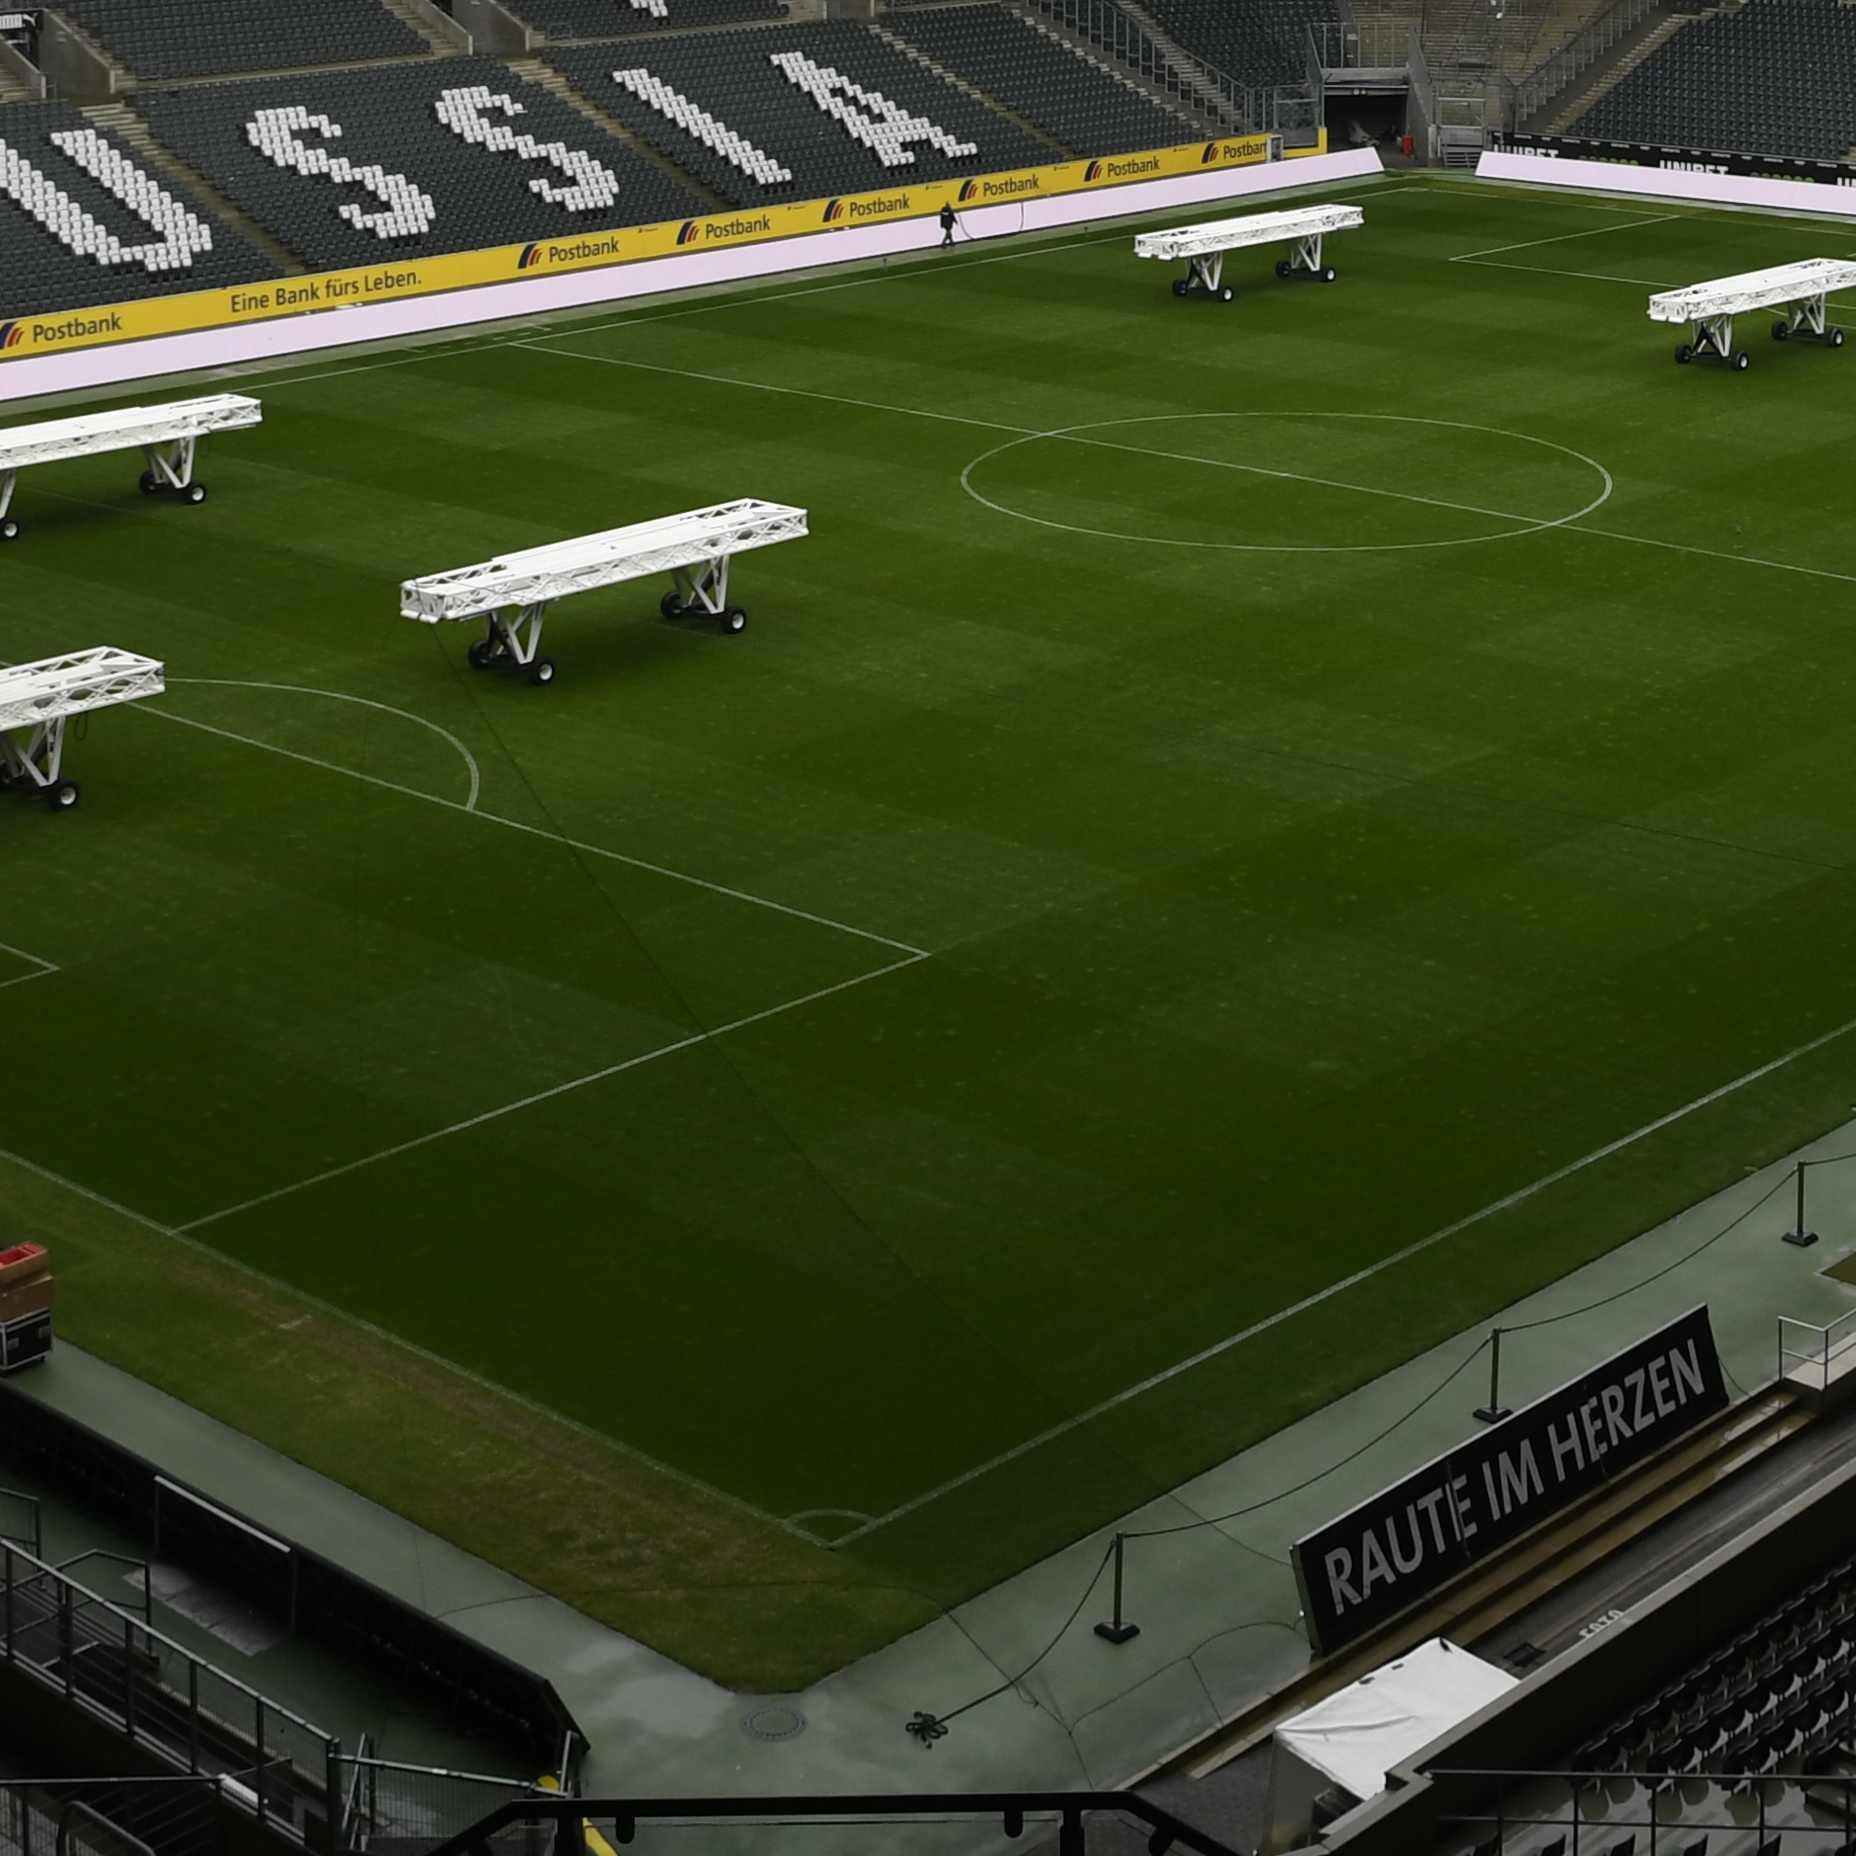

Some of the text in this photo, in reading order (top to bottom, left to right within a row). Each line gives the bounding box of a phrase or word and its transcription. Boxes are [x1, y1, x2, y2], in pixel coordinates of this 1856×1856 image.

[1223, 140, 1266, 159] Postban
[1107, 157, 1160, 180] Postbank
[982, 176, 1039, 197] Postbank
[848, 197, 910, 219] Postbank
[704, 215, 771, 242] Postbank
[548, 236, 620, 264] Postbank
[230, 269, 422, 313] Eine Bank fürs Leben.
[33, 311, 122, 344] Postbank
[1324, 1338, 1706, 1616] RAUTE IM HERZEN
